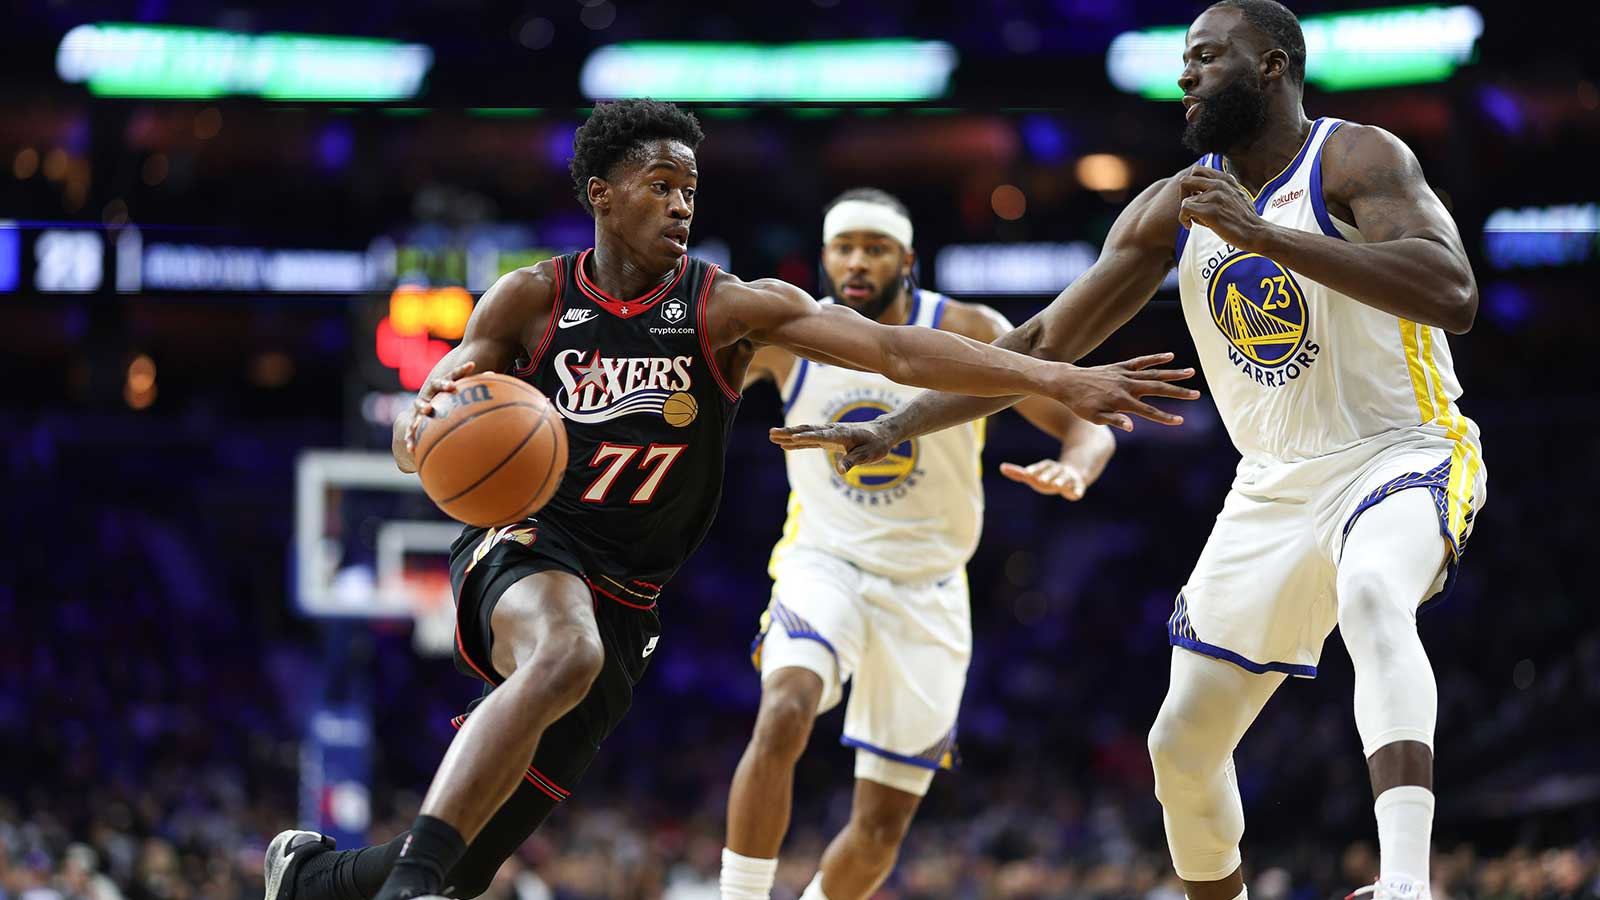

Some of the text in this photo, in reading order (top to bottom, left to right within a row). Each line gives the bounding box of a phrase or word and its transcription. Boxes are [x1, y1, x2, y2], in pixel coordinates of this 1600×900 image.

[1271, 188, 1305, 208] Rakuten
[1202, 244, 1236, 279] GOLD
[1260, 275, 1291, 310] 23
[565, 308, 592, 321] NIKE
[649, 326, 695, 336] crypto.com
[554, 349, 693, 411] SIXERS
[1227, 340, 1320, 387] WARRIORS
[581, 441, 688, 504] 77
